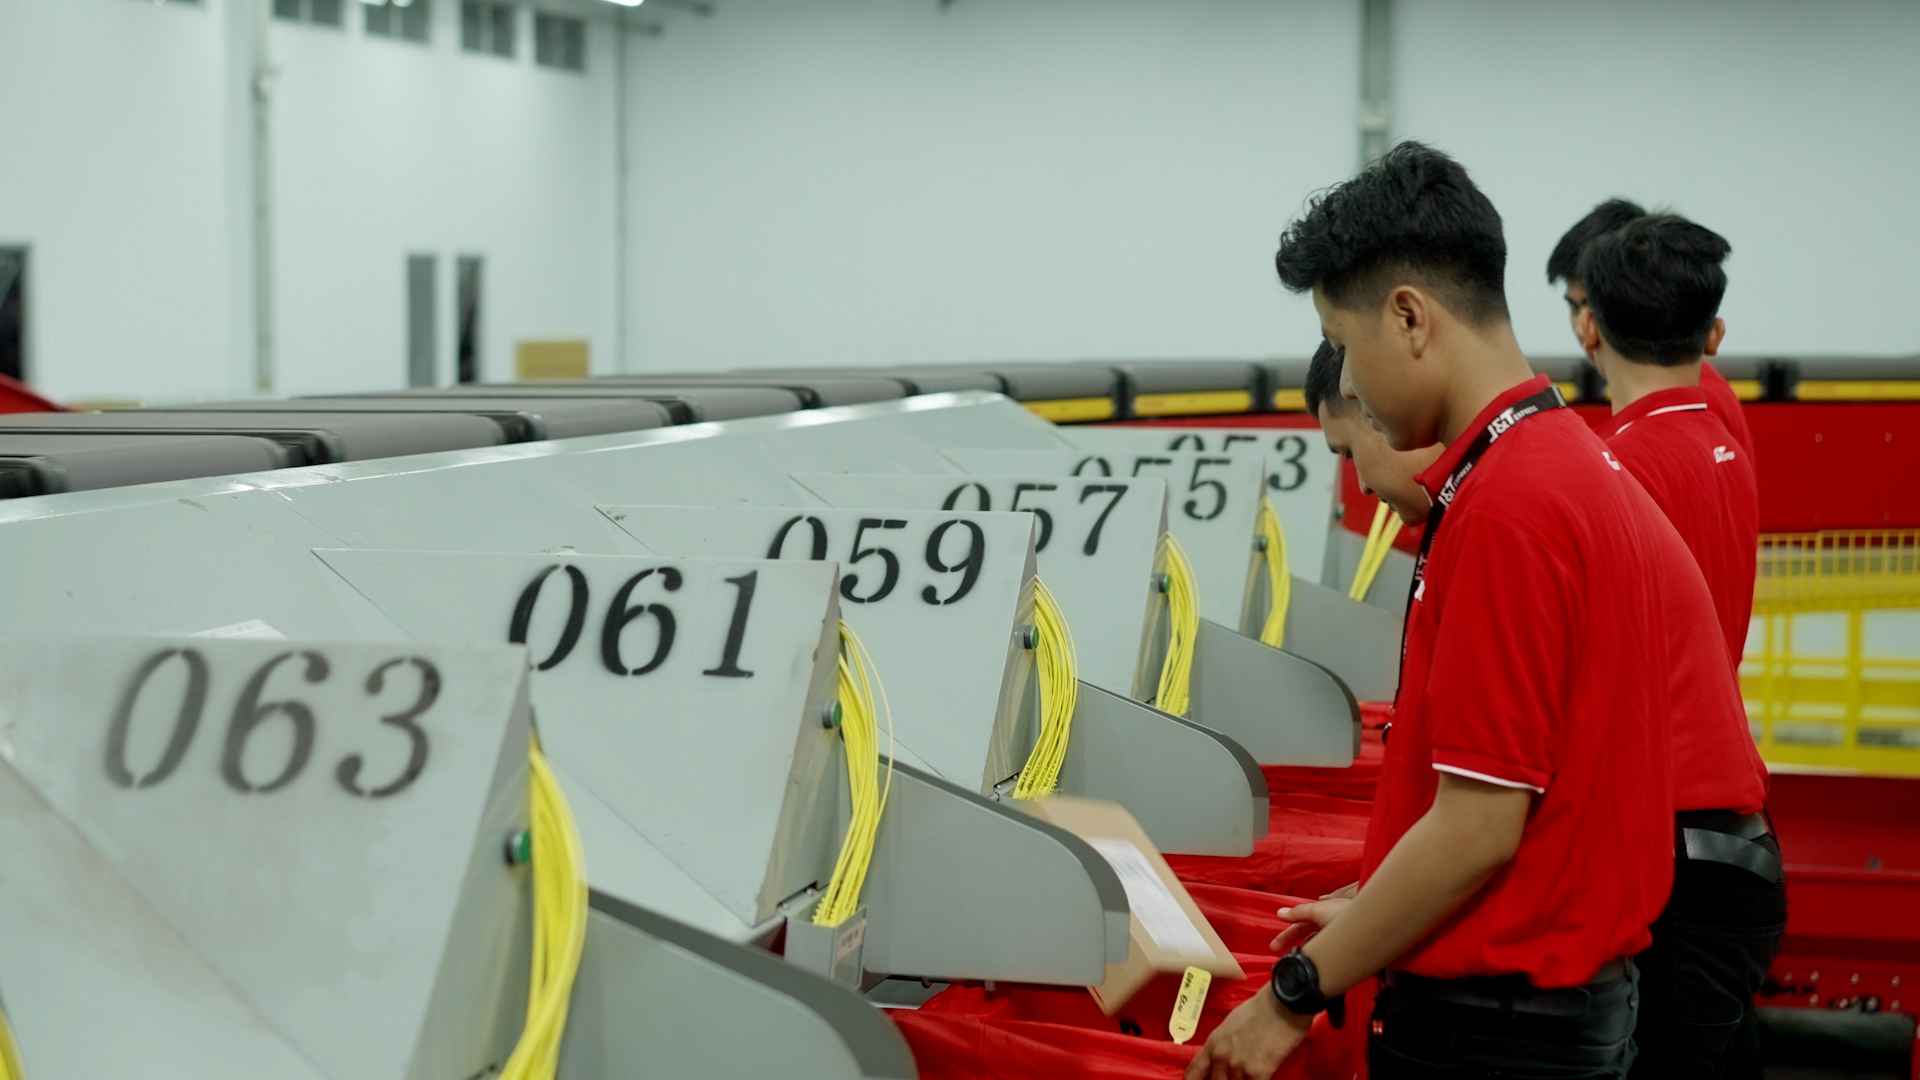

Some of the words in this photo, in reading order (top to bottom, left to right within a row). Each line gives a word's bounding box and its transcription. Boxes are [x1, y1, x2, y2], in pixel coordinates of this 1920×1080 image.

[1486, 406, 1515, 444] J&T
[508, 564, 758, 679] 061
[103, 648, 443, 799] 063
